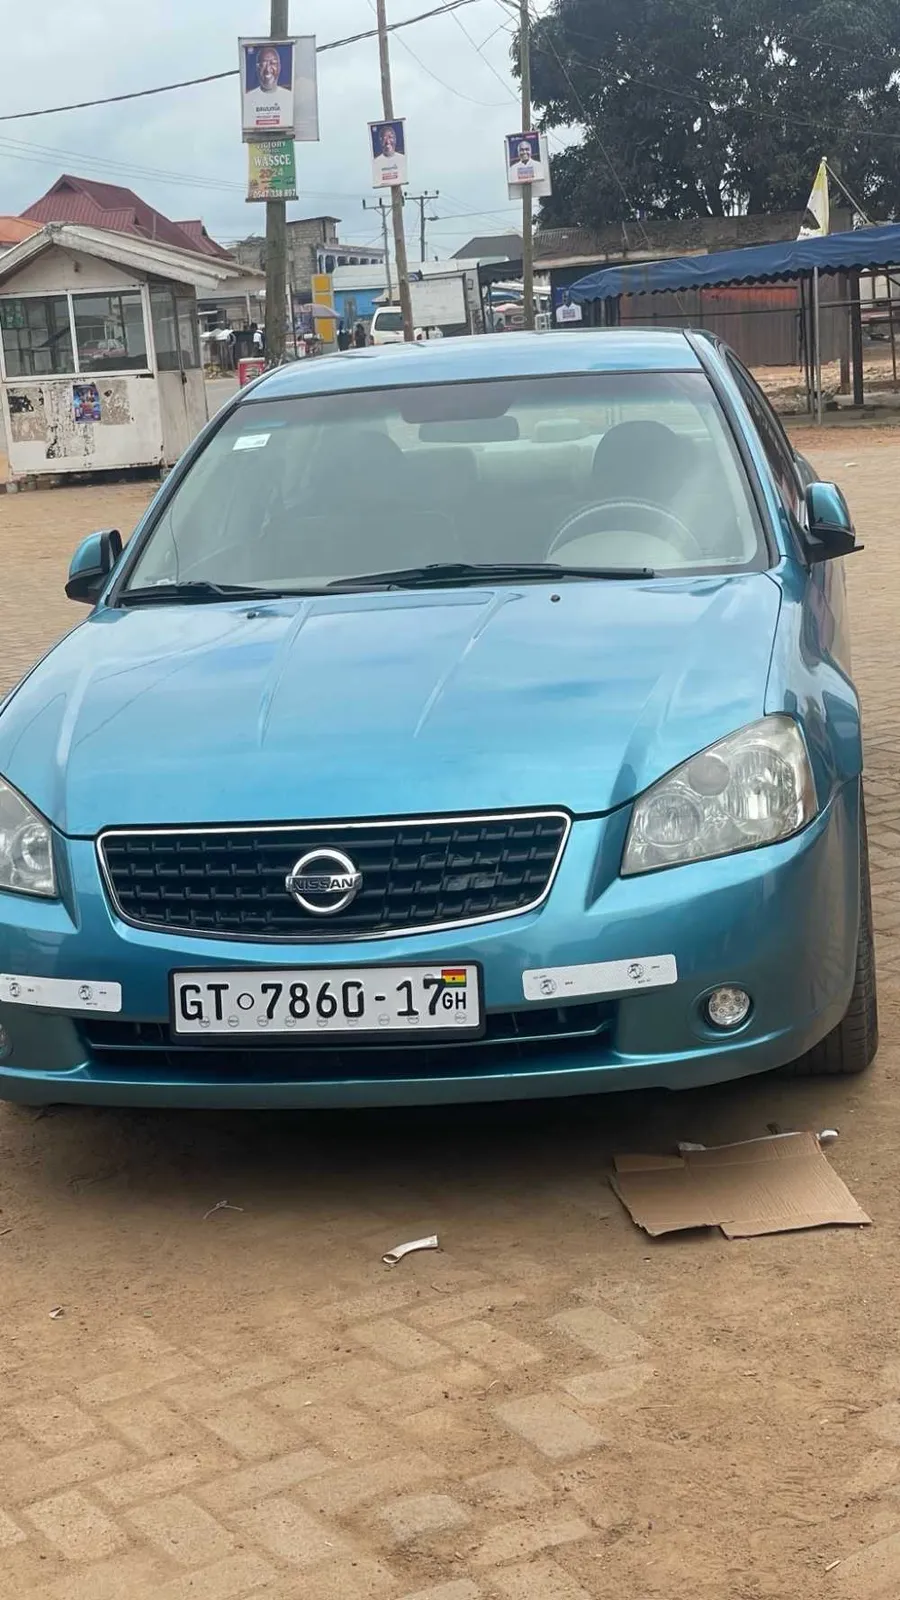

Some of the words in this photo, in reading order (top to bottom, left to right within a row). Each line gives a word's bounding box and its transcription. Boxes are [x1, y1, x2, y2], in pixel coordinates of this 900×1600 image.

[254, 154, 291, 166] WASSCE
[259, 168, 284, 178] 2024
[292, 877, 354, 891] NISSAN
[180, 983, 230, 1021] GT
[442, 991, 467, 1011] GH
